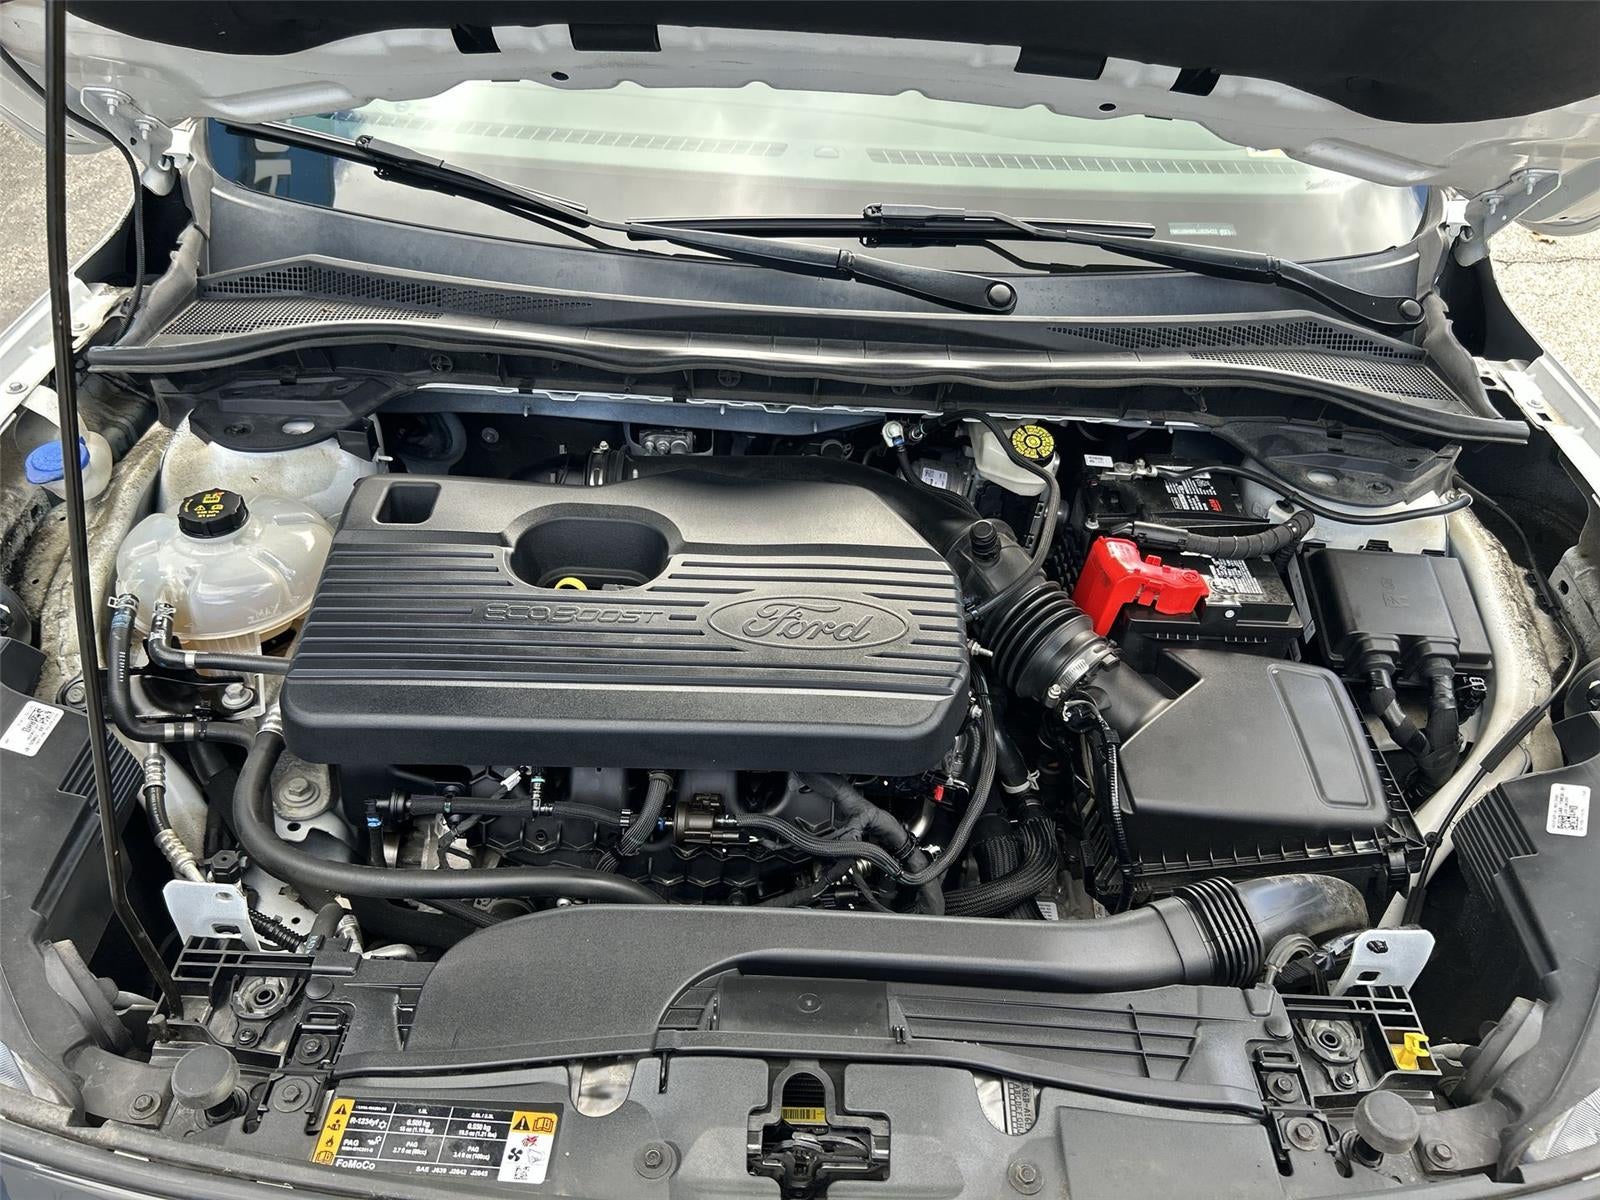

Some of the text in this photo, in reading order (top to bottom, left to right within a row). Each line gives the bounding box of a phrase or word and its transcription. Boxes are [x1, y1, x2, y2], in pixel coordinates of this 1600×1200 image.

[483, 602, 668, 625] ECOBOOST
[743, 602, 874, 642] Ford
[349, 1117, 378, 1127] R-1234yf
[335, 1158, 376, 1170] FoMoCo
[416, 1165, 430, 1173] SAE
